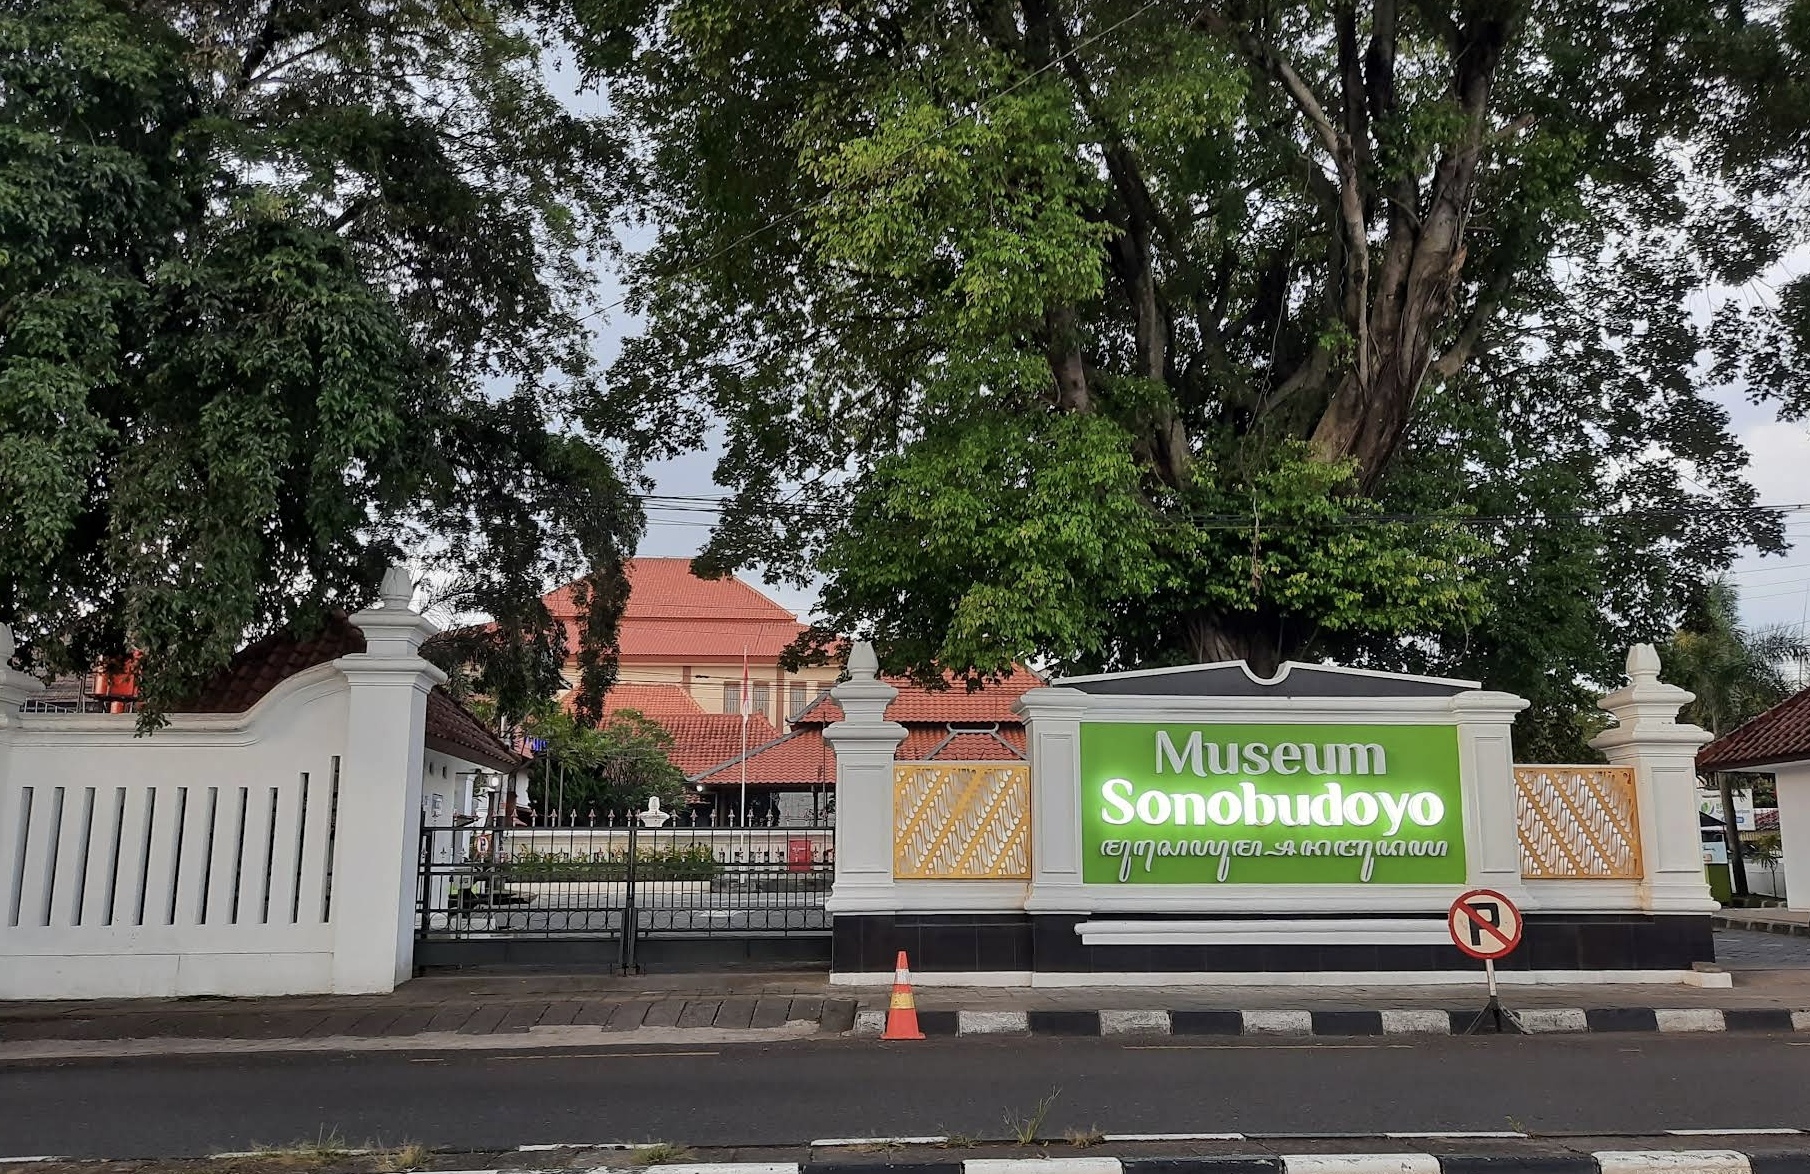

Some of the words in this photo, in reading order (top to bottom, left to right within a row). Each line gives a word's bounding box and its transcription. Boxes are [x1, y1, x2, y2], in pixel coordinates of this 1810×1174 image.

[1155, 730, 1387, 778] Museum
[1101, 778, 1445, 837] Sonobudoyo
[1467, 902, 1501, 946] P
